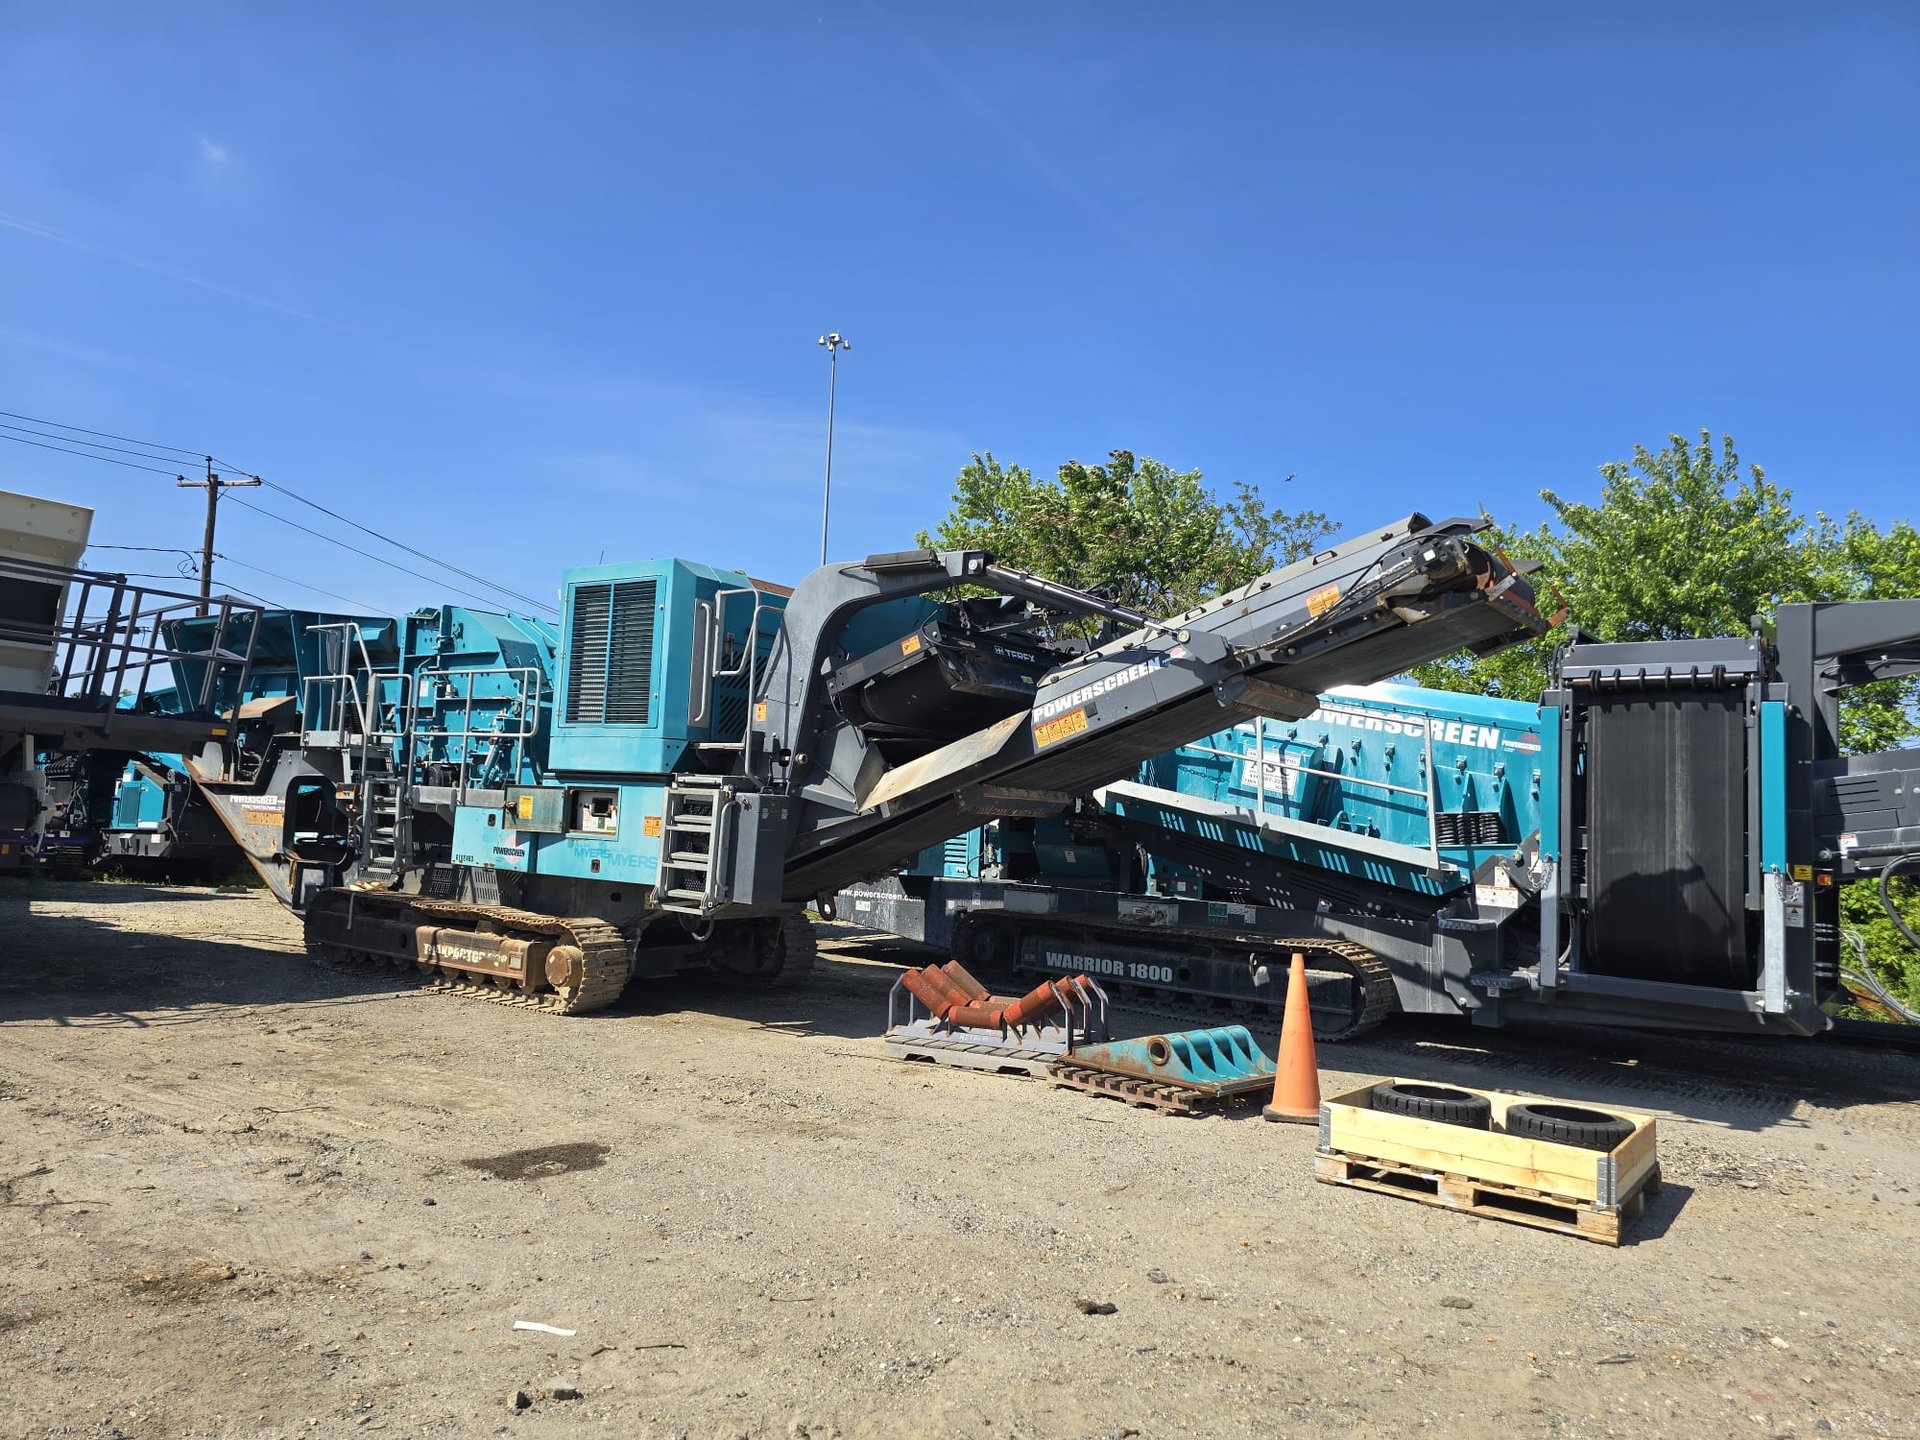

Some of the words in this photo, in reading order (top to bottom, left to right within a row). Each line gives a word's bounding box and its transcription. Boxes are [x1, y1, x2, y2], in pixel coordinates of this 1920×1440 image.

[1033, 656, 1161, 723] POWERSCREEN
[492, 846, 526, 858] POWERSCREEN
[1045, 951, 1124, 976] WARRIOR
[1127, 962, 1173, 983] 1800
